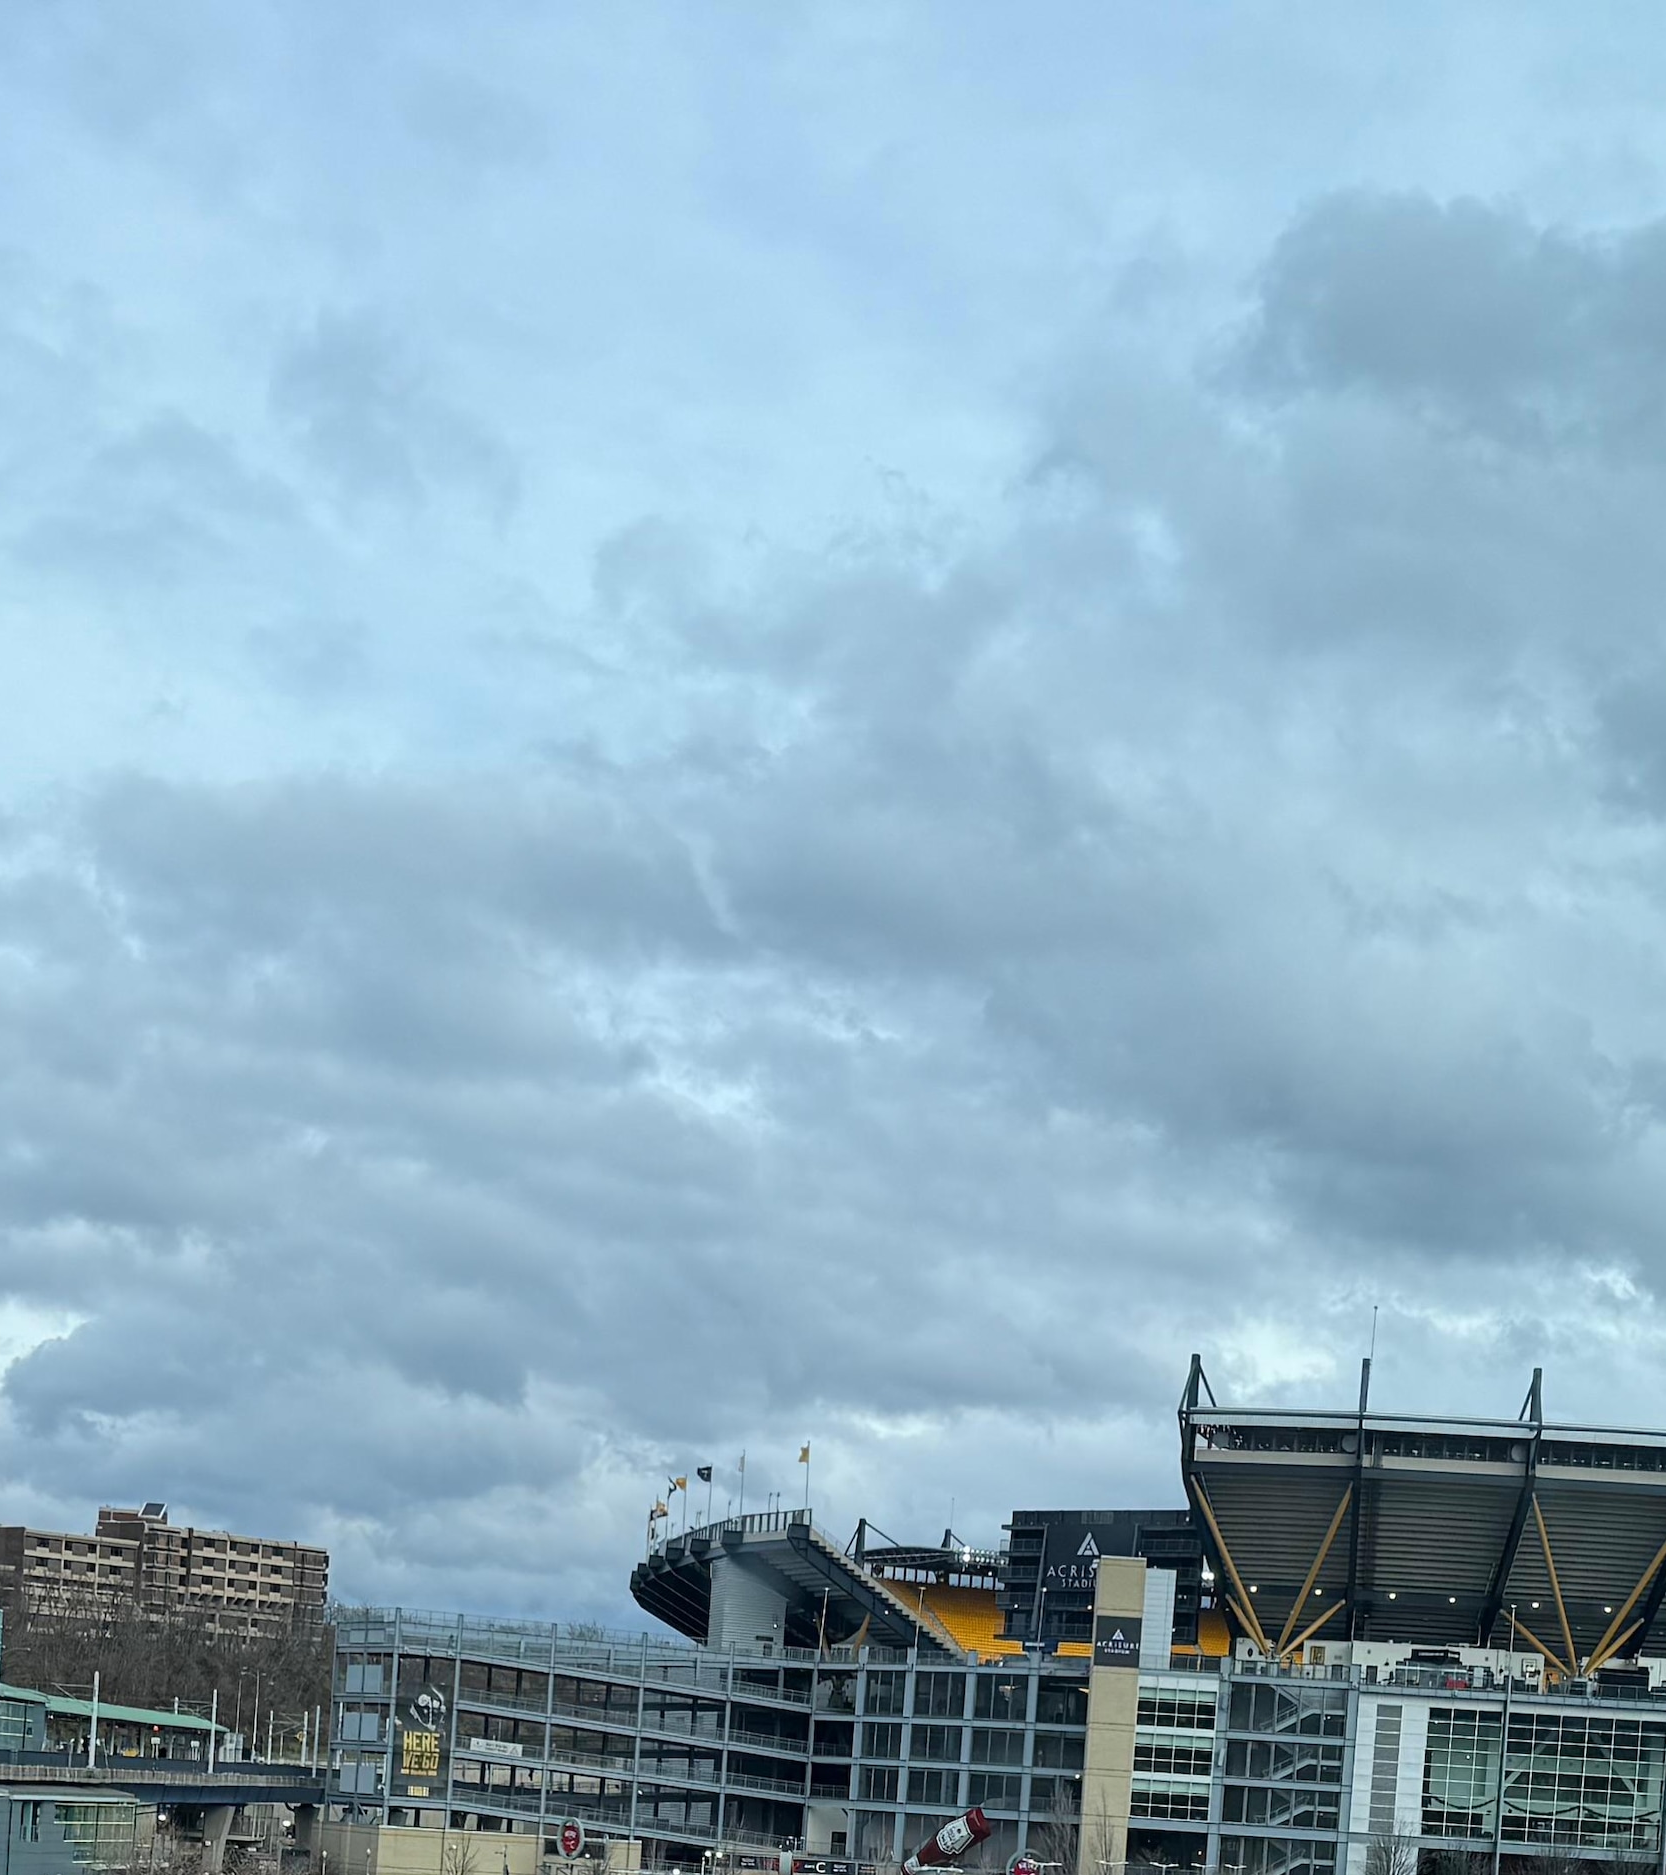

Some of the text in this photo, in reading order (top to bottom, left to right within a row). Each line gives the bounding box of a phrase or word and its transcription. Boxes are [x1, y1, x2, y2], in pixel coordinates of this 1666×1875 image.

[403, 1730, 440, 1753] HERE
[402, 1751, 440, 1770] WE GO
[816, 1862, 826, 1873] C
